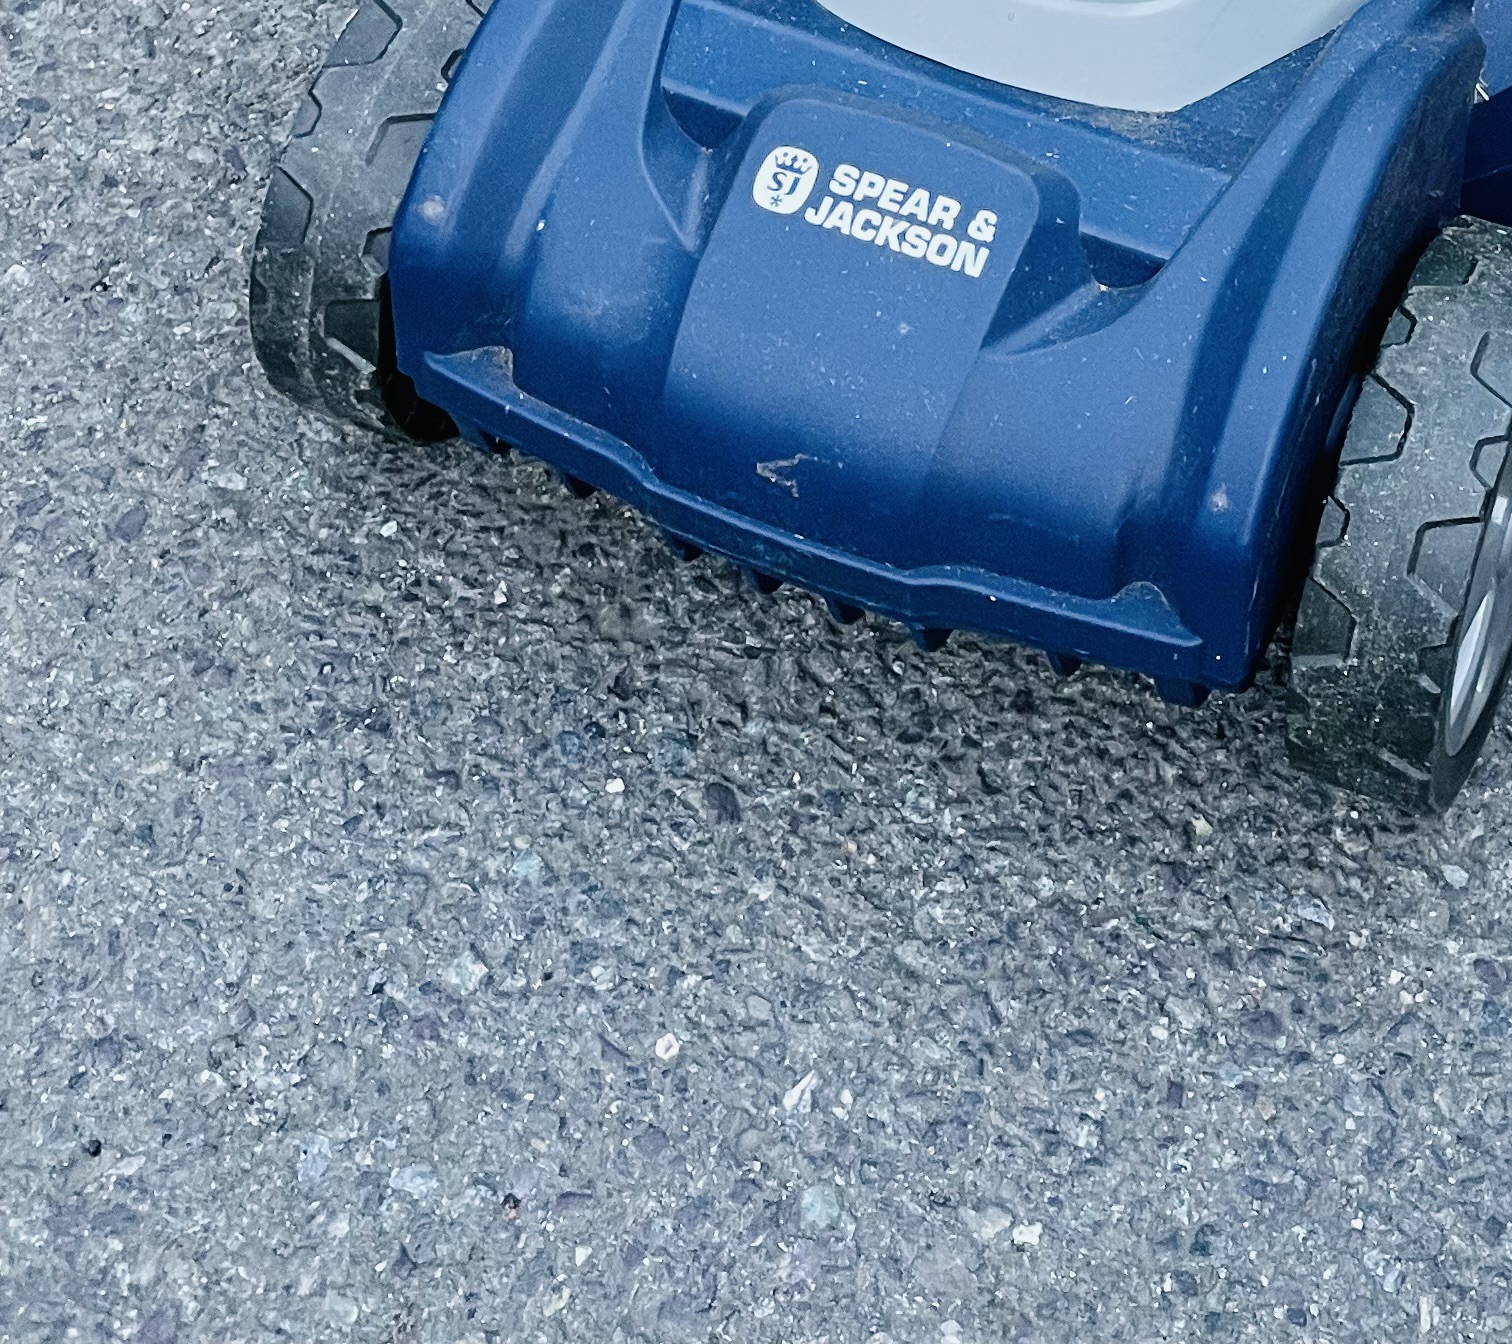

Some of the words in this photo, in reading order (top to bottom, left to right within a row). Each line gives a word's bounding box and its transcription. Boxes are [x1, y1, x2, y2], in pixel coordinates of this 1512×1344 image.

[767, 171, 801, 196] SJ
[829, 164, 961, 230] SPEAR
[966, 209, 998, 243] &
[804, 196, 990, 278] JACKSON
